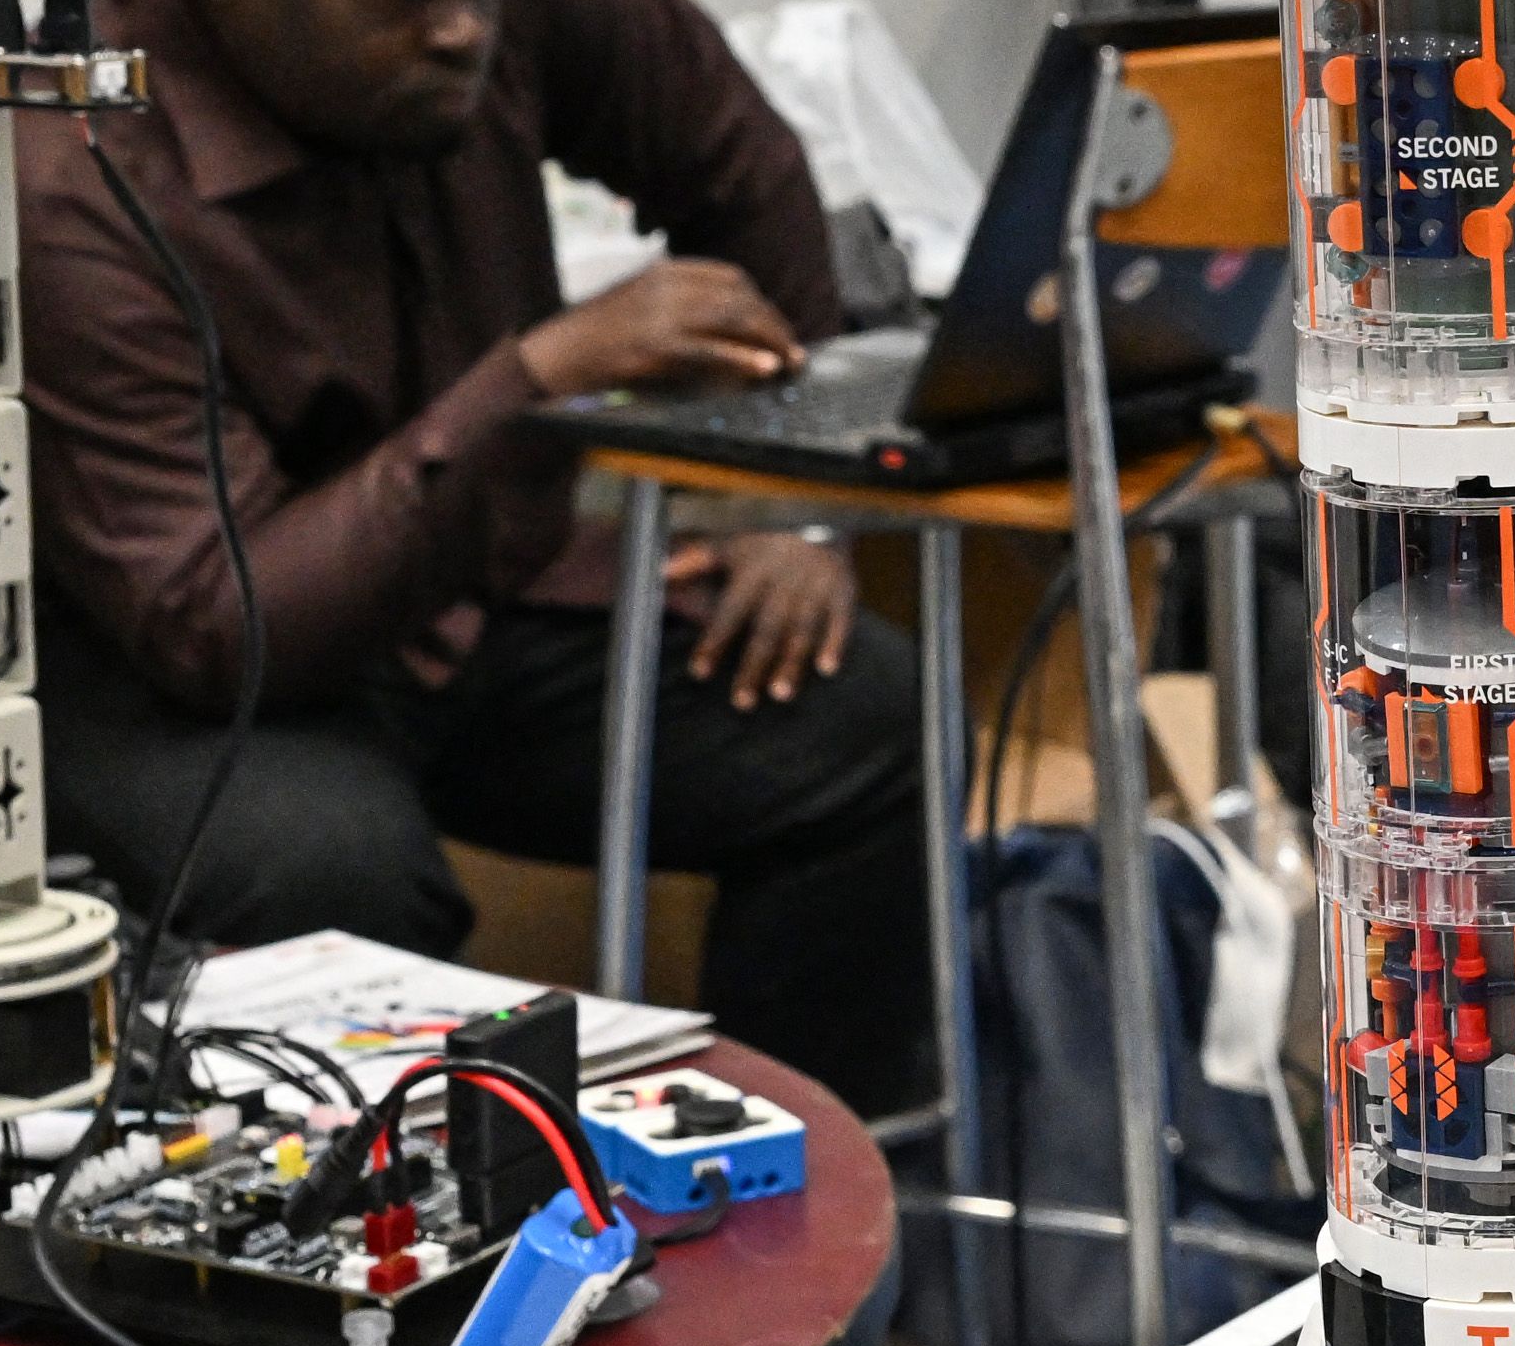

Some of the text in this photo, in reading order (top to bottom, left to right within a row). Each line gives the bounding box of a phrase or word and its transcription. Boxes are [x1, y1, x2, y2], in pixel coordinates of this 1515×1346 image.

[1397, 135, 1498, 159] SECOND
[1423, 166, 1500, 190] STAGE
[1323, 638, 1349, 664] S-IC
